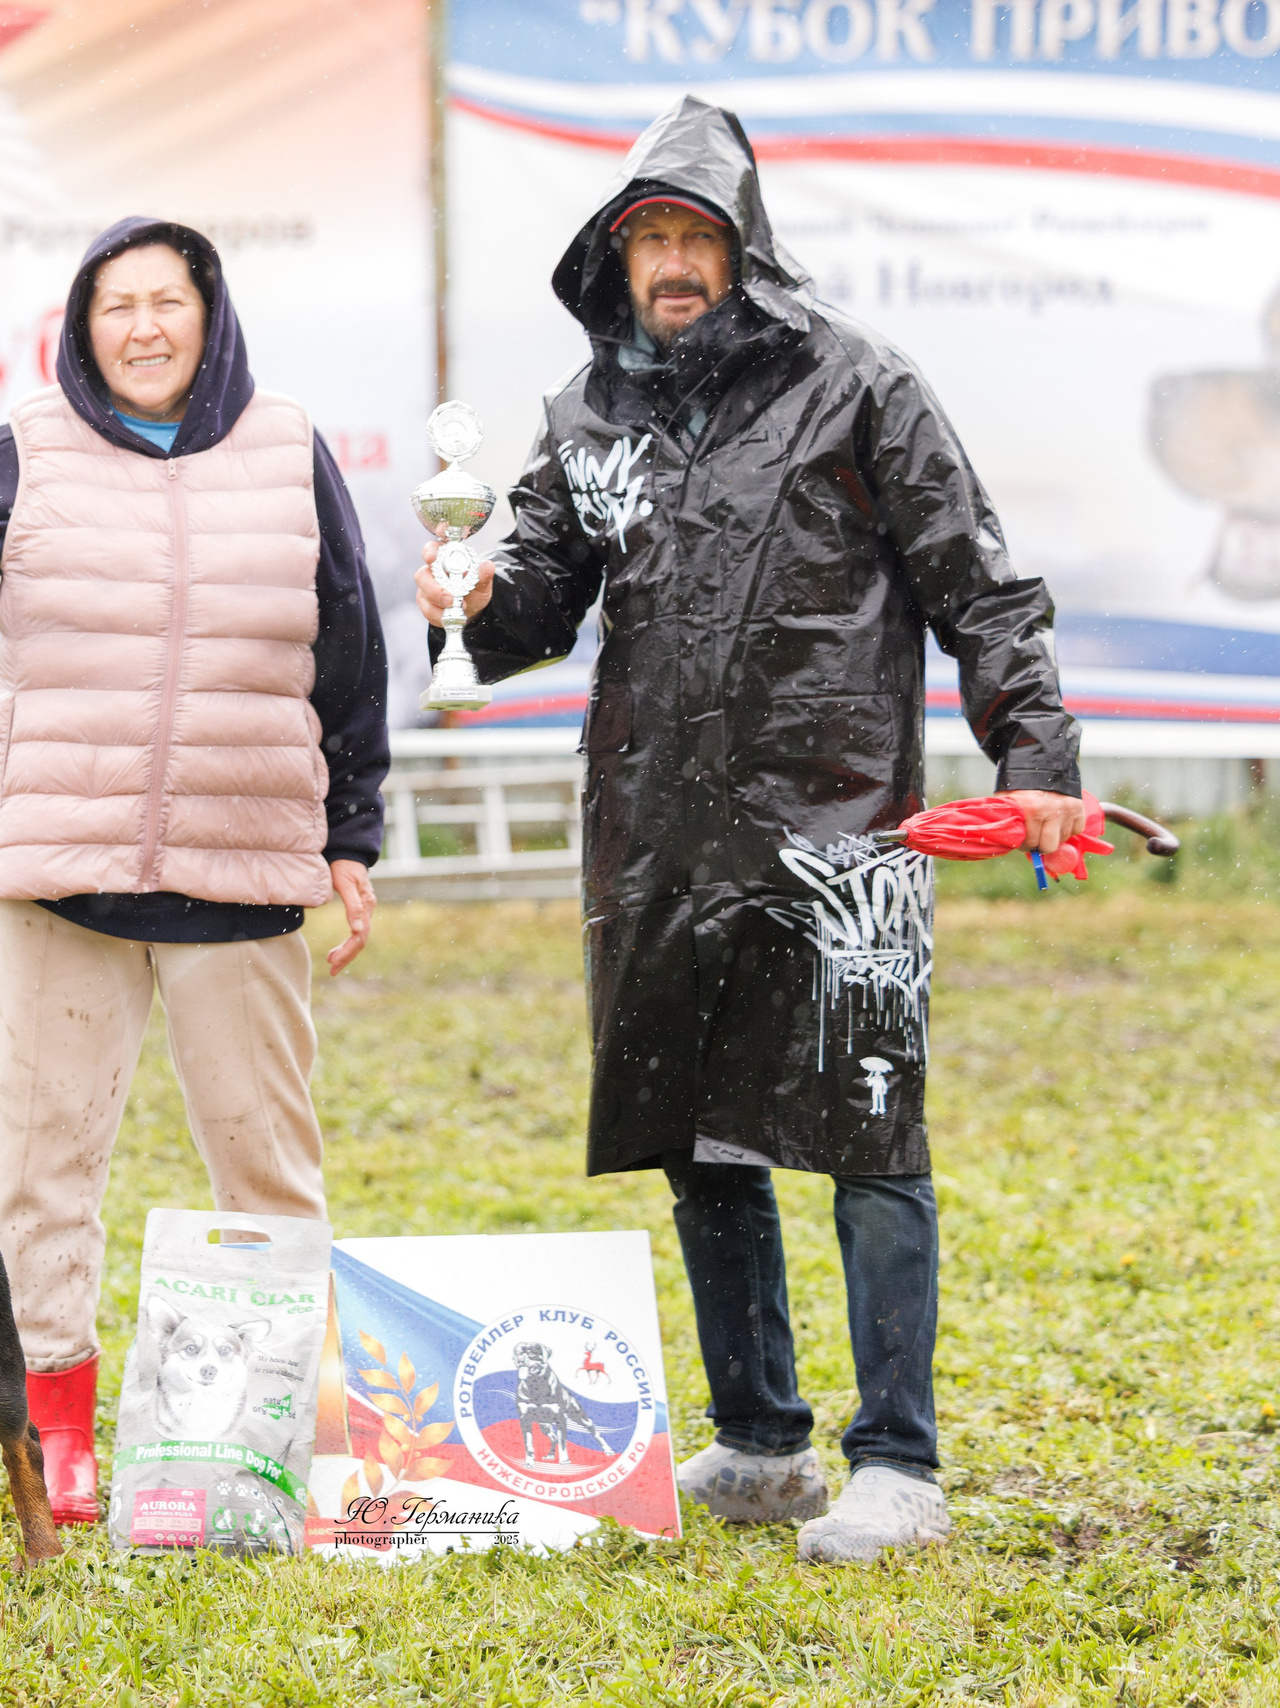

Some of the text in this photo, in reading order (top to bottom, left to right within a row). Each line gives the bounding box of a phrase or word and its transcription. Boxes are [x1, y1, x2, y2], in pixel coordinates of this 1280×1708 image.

[154, 1277, 316, 1307] ACARI CIAR
[287, 1305, 314, 1315] eco
[459, 1310, 653, 1418] РОТВЕЙЛЕР КЛУБ РОССИИ
[136, 1442, 212, 1460] Professional
[215, 1444, 243, 1461] Line
[245, 1449, 266, 1473] Dog
[477, 1441, 646, 1499] НИЖЕГОРОДСКОЕ РО
[140, 1501, 197, 1512] AURORA
